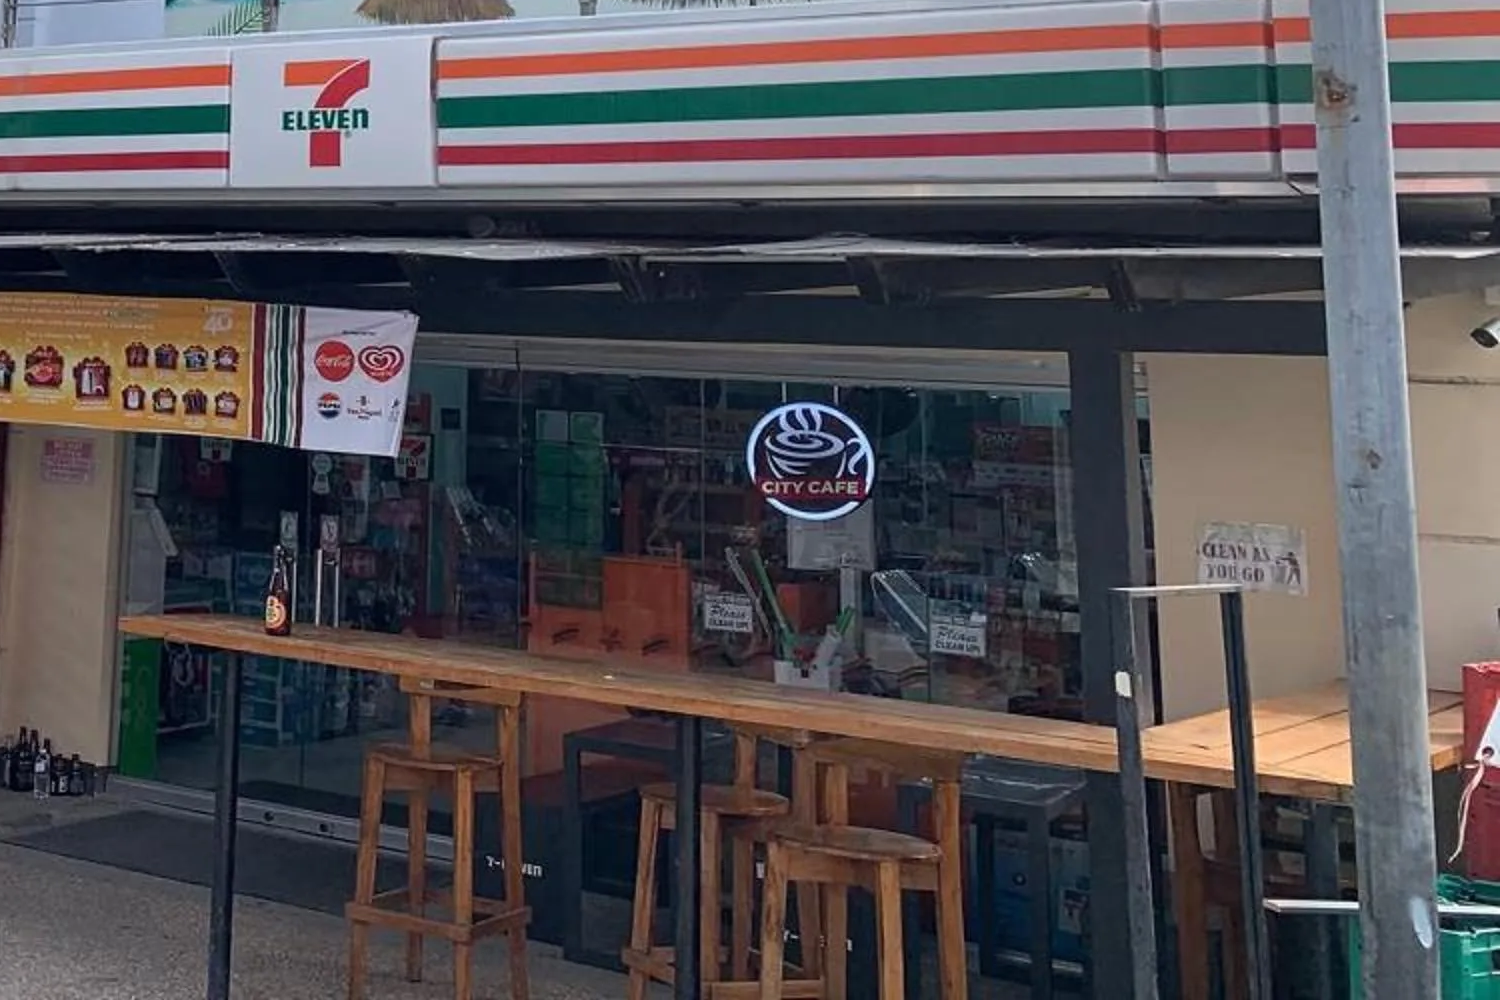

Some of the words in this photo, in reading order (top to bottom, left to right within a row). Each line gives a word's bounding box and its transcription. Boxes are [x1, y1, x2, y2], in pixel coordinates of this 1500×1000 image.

[284, 58, 370, 168] 7
[761, 480, 804, 494] CITY
[807, 480, 860, 495] CAFE
[1202, 542, 1247, 560] CLEAN
